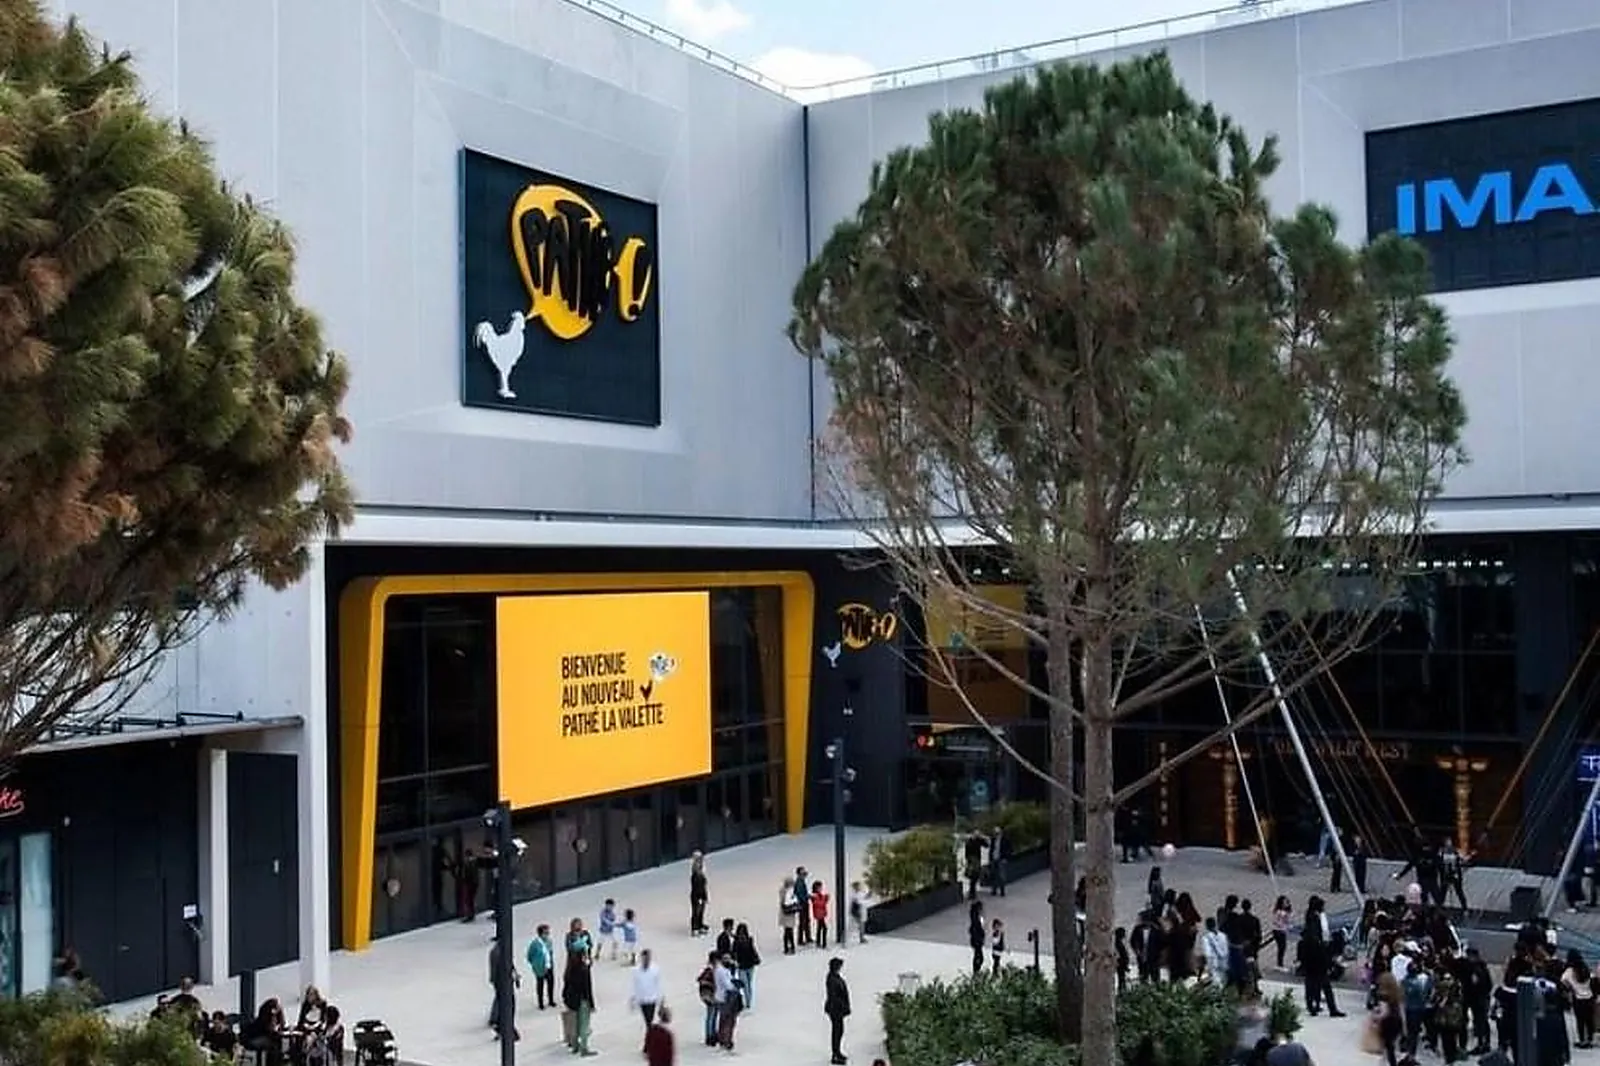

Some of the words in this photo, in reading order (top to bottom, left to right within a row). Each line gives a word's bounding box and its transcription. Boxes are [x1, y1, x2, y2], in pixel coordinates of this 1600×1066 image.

[1396, 162, 1600, 236] IMA
[562, 652, 626, 679] BIENVENUE
[562, 684, 578, 708] AU
[582, 680, 634, 706] NOUVEAU
[602, 710, 616, 732] LA
[618, 703, 664, 729] VALETTE
